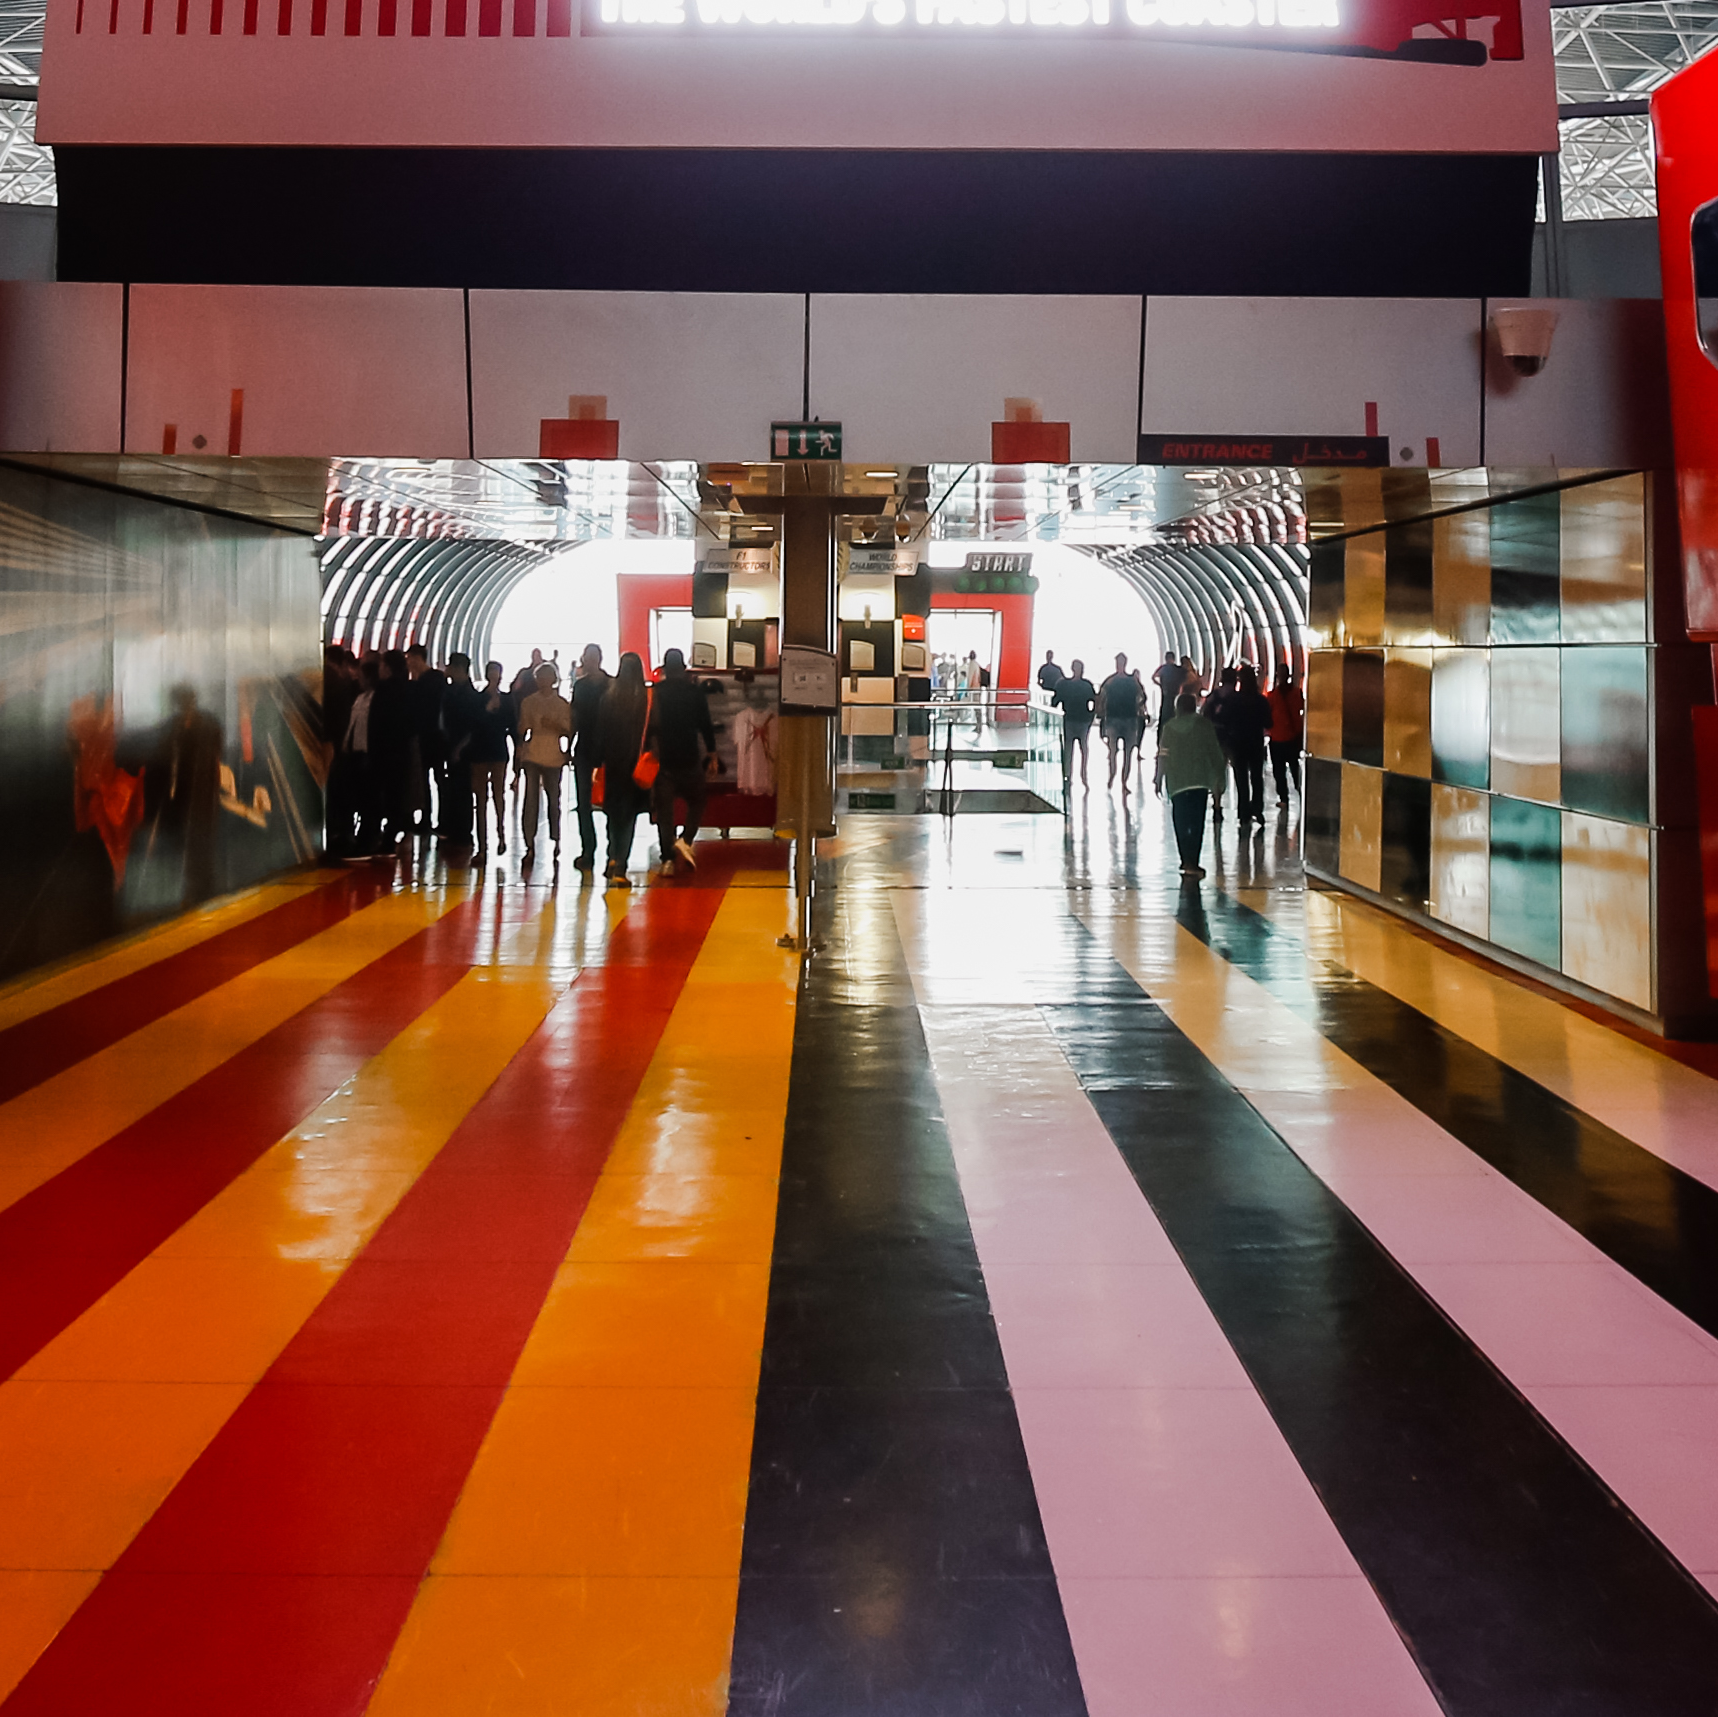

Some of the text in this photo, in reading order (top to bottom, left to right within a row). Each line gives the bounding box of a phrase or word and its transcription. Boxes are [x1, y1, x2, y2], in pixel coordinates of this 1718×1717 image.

[1161, 443, 1274, 460] ENTRANCE
[1292, 442, 1368, 464] مدخل
[736, 551, 747, 561] F1
[869, 553, 898, 561] WORLD
[849, 562, 914, 571] CHAMPIONSHIPS
[971, 554, 1027, 572] START
